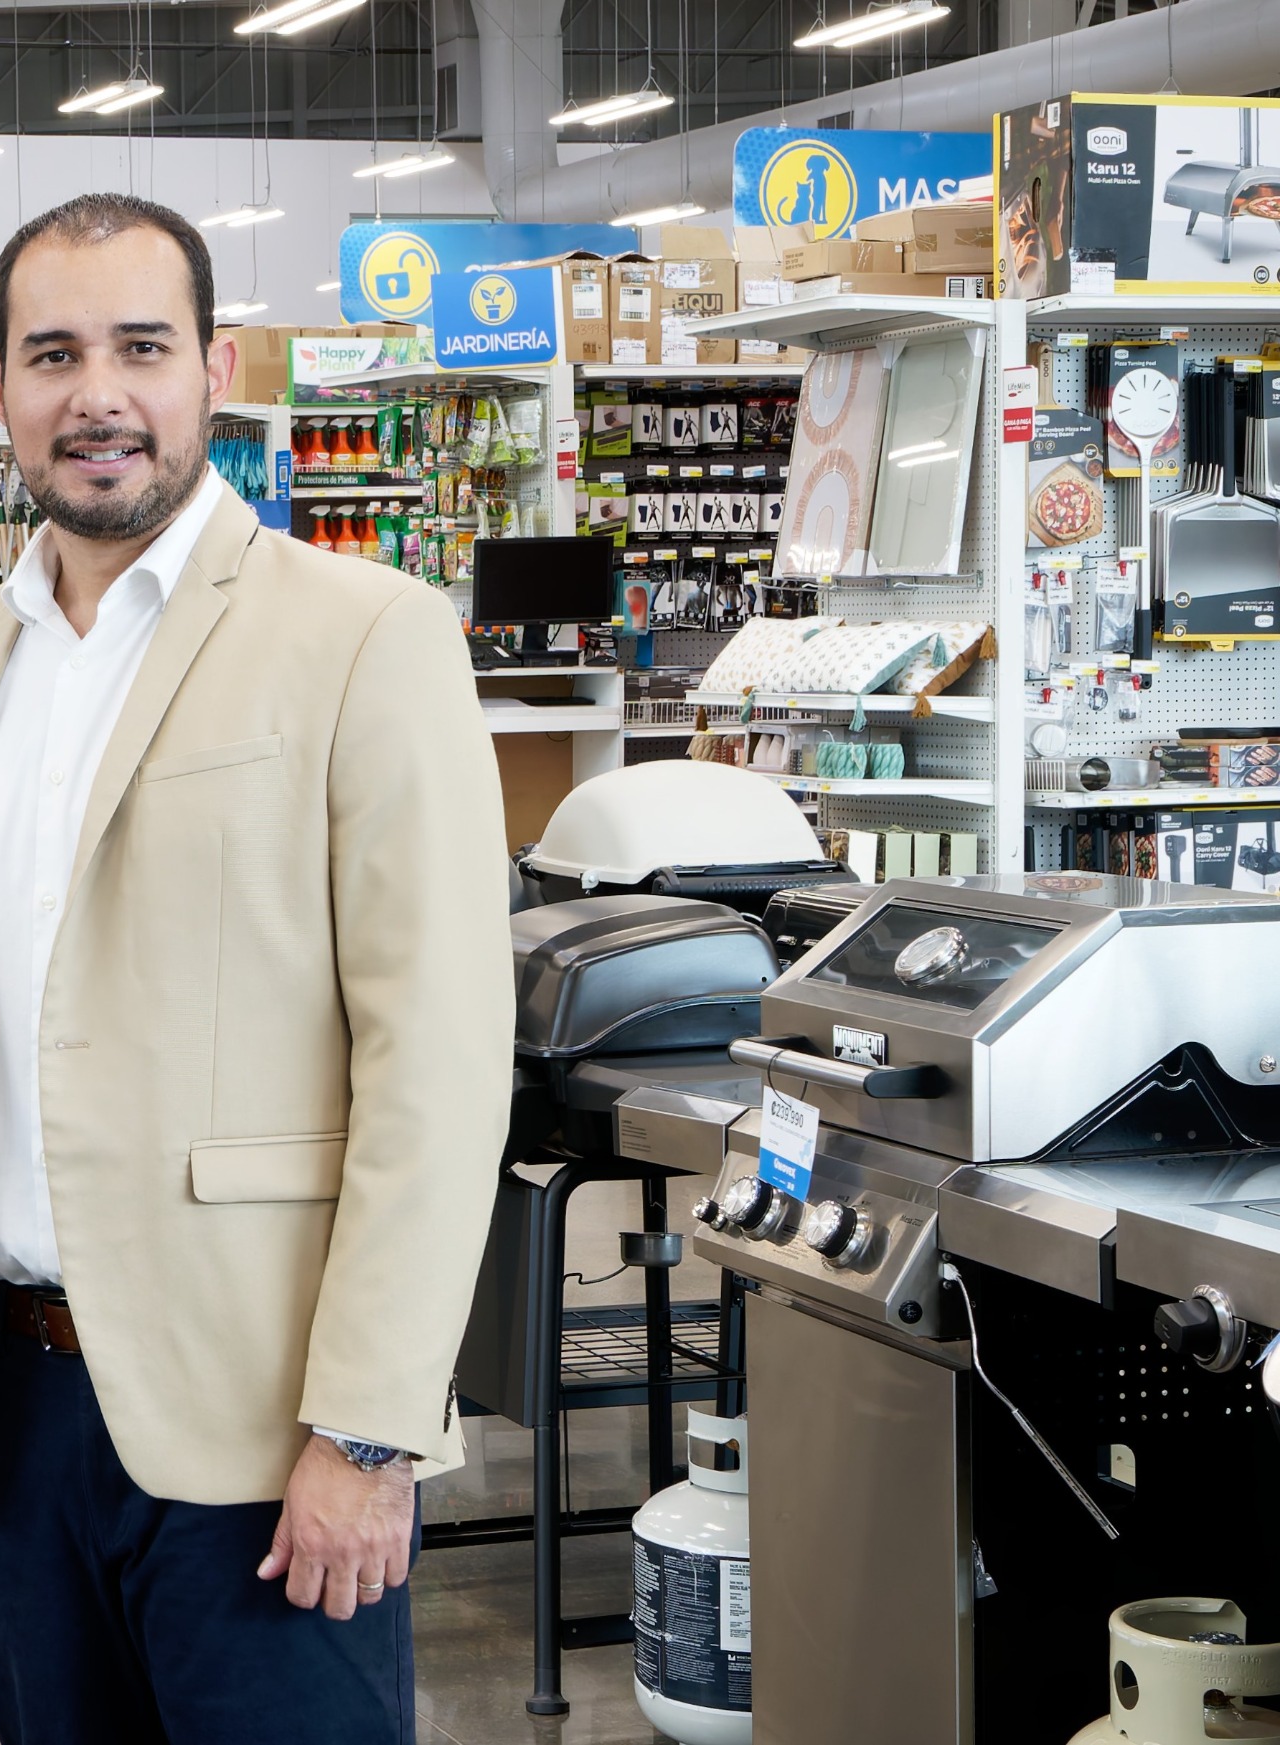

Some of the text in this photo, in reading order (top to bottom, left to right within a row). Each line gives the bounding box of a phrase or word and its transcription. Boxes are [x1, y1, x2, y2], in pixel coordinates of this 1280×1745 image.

[1093, 135, 1121, 145] ooni
[1087, 162, 1136, 175] Karu 12
[440, 327, 552, 356] JARDINERÍA
[319, 346, 366, 362] Happy
[319, 359, 357, 372] Plant
[1042, 358, 1050, 378] ooni
[1007, 382, 1031, 391] LifeMiles
[297, 474, 358, 484] Protectores de Plantas
[834, 1027, 883, 1056] MONUMENT
